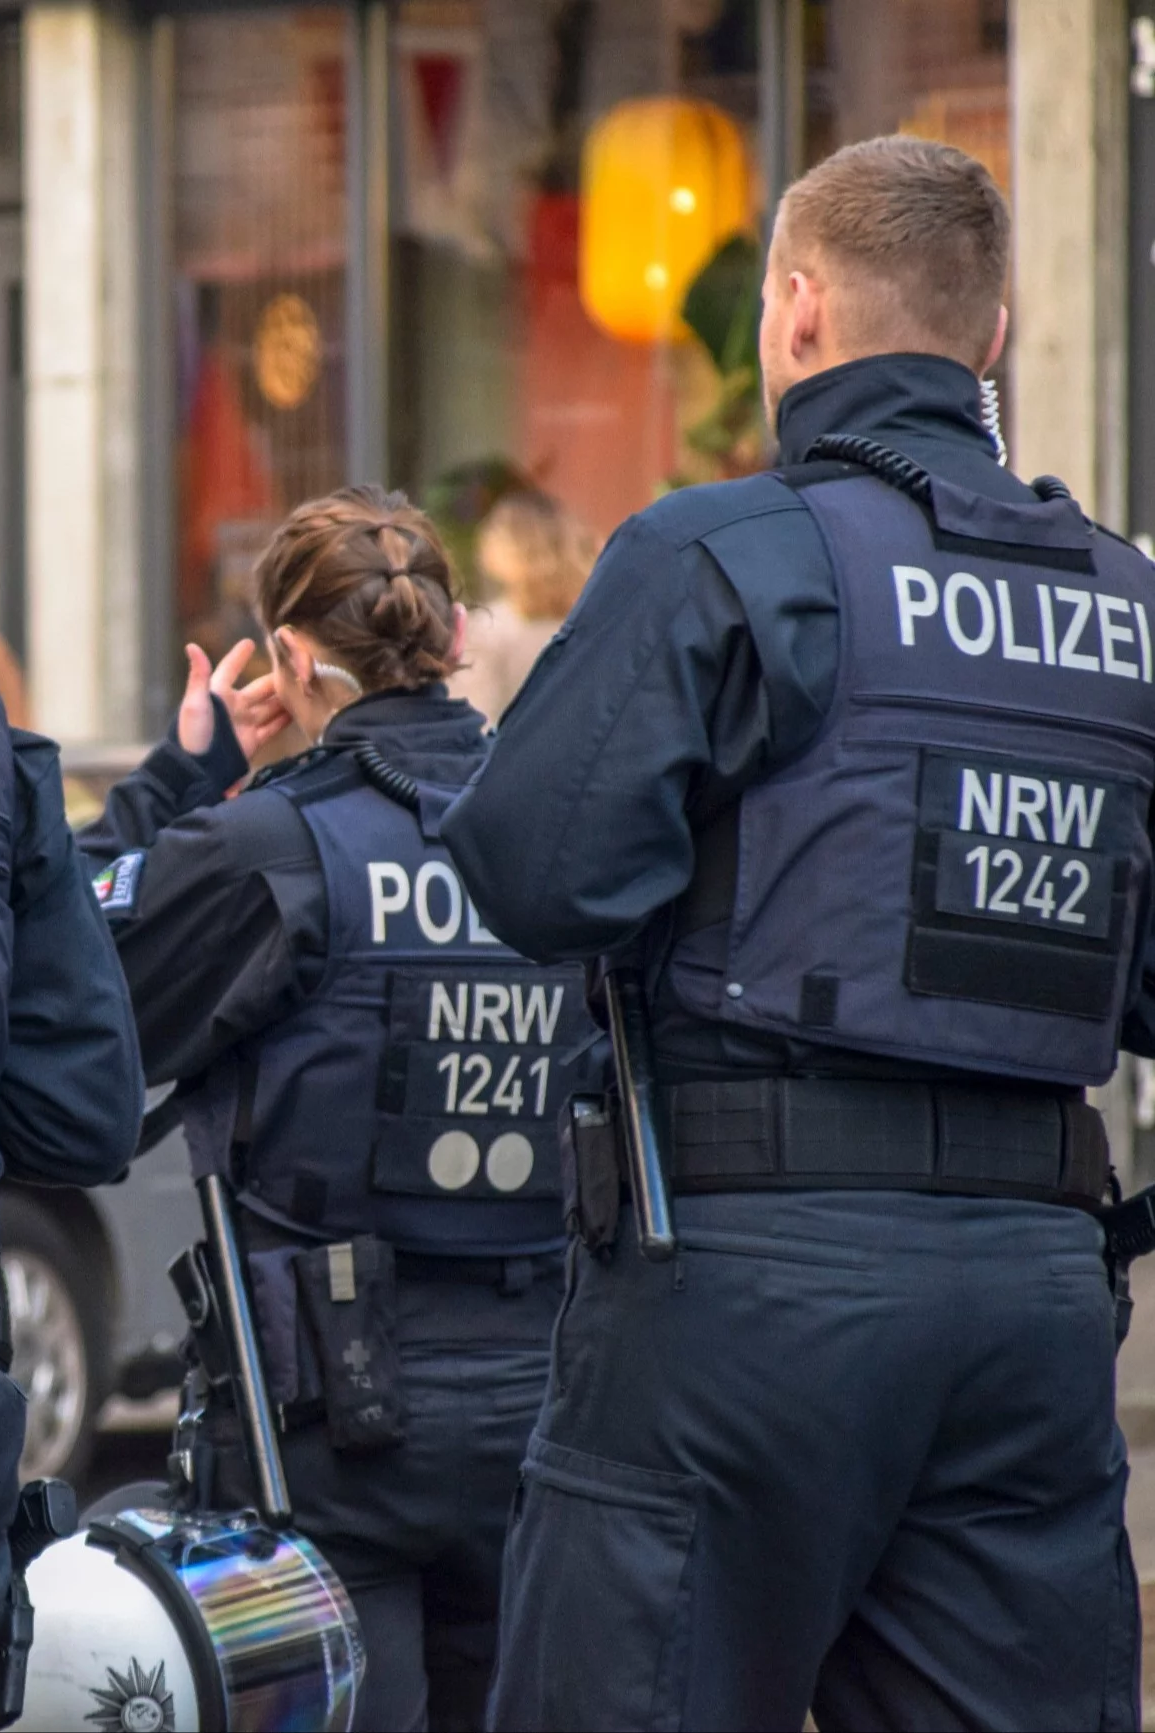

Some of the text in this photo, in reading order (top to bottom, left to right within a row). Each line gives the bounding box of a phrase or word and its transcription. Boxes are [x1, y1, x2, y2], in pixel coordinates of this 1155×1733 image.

[892, 565, 1153, 684] POLIZEI
[959, 767, 1106, 849] NRW
[964, 844, 1093, 925] 1242
[427, 981, 565, 1045] NRW
[437, 1051, 550, 1116] 1241
